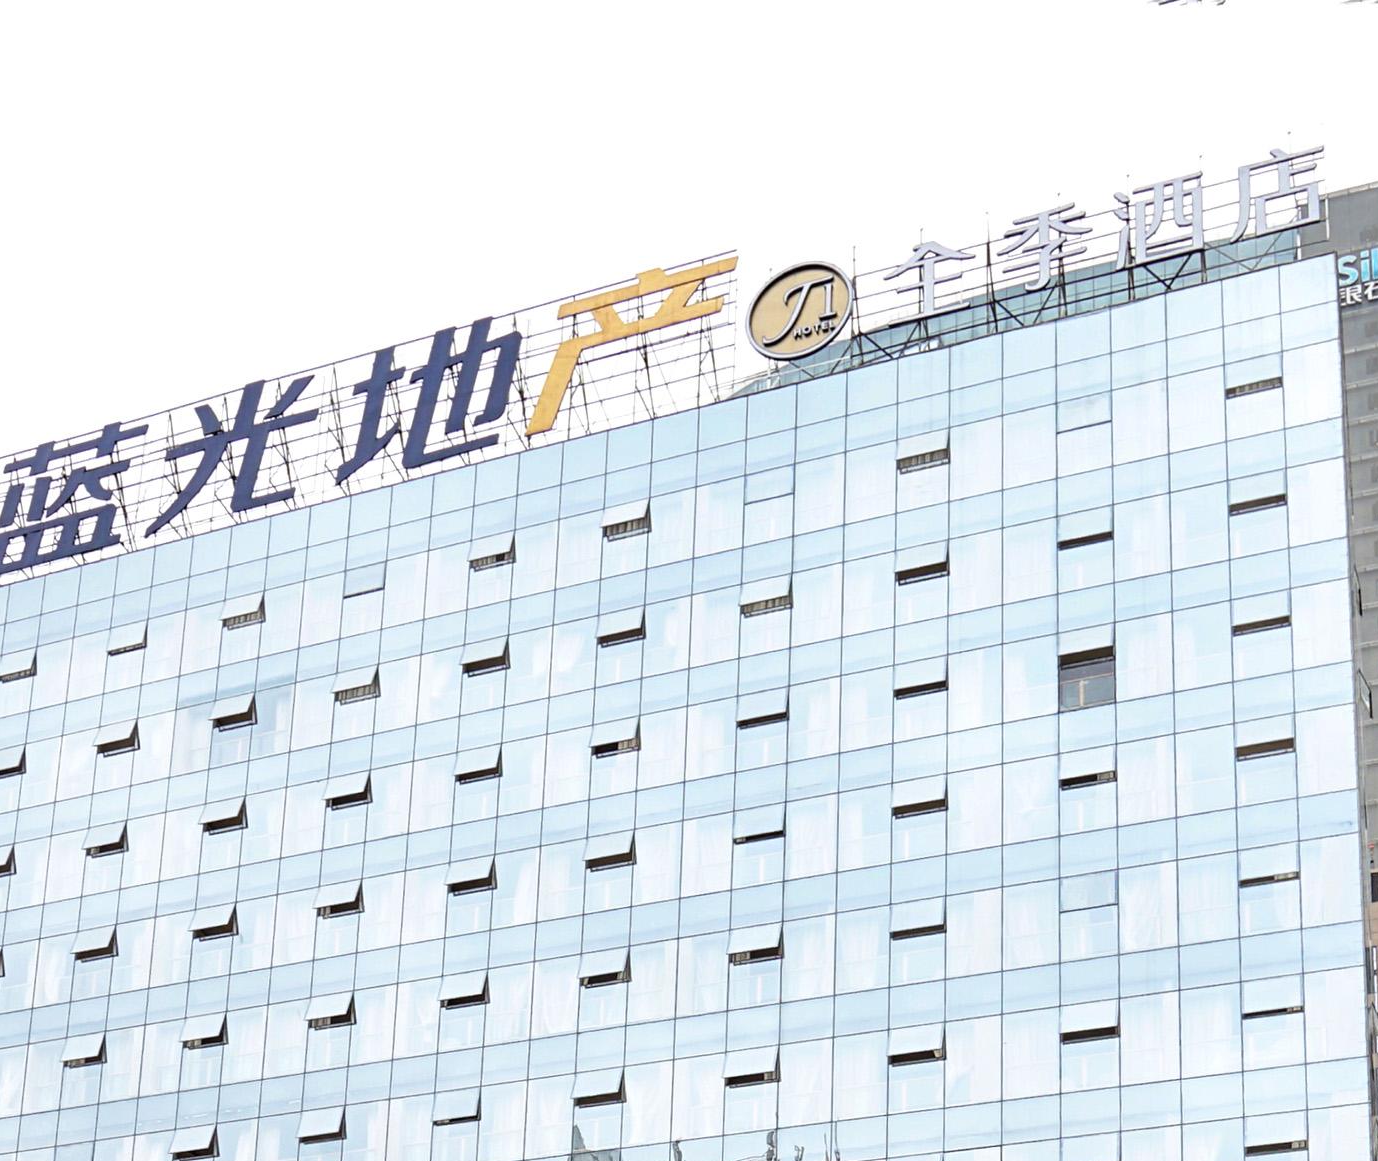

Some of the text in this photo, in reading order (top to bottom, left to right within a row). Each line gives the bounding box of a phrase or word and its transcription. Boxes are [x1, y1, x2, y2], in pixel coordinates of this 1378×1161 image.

[884, 146, 1325, 318] 全季酒店
[794, 320, 836, 340] HOTEL
